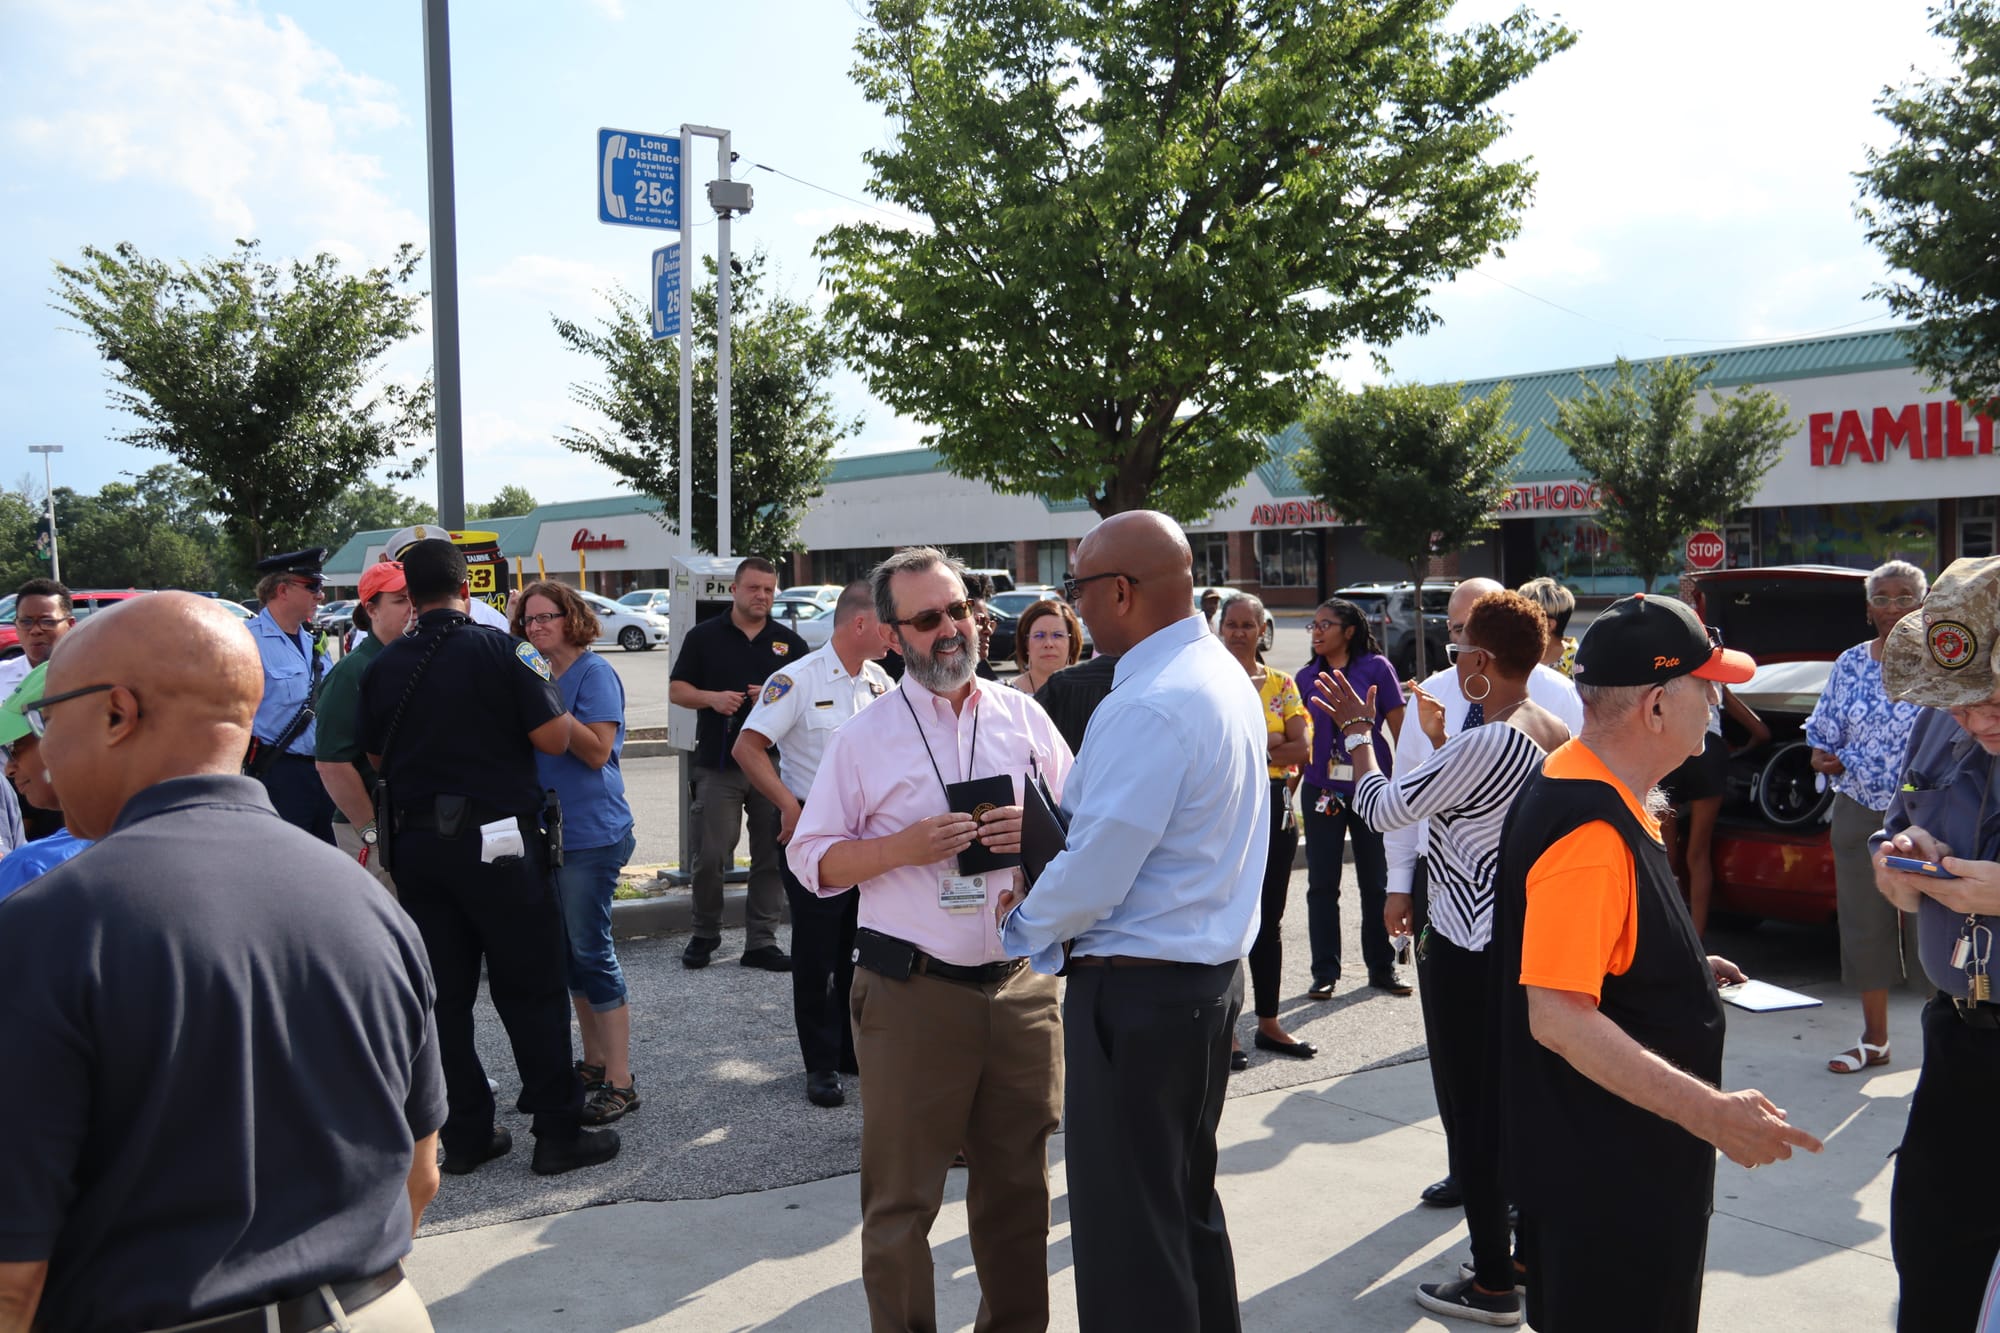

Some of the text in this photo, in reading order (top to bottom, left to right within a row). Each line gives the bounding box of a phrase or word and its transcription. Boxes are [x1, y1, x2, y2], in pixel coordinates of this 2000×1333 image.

[640, 137, 668, 153] Long
[628, 148, 680, 164] Distance
[636, 161, 673, 172] Anywhere
[634, 180, 674, 207] 25¢
[1689, 543, 1722, 557] STOP
[1653, 655, 1681, 670] Pete
